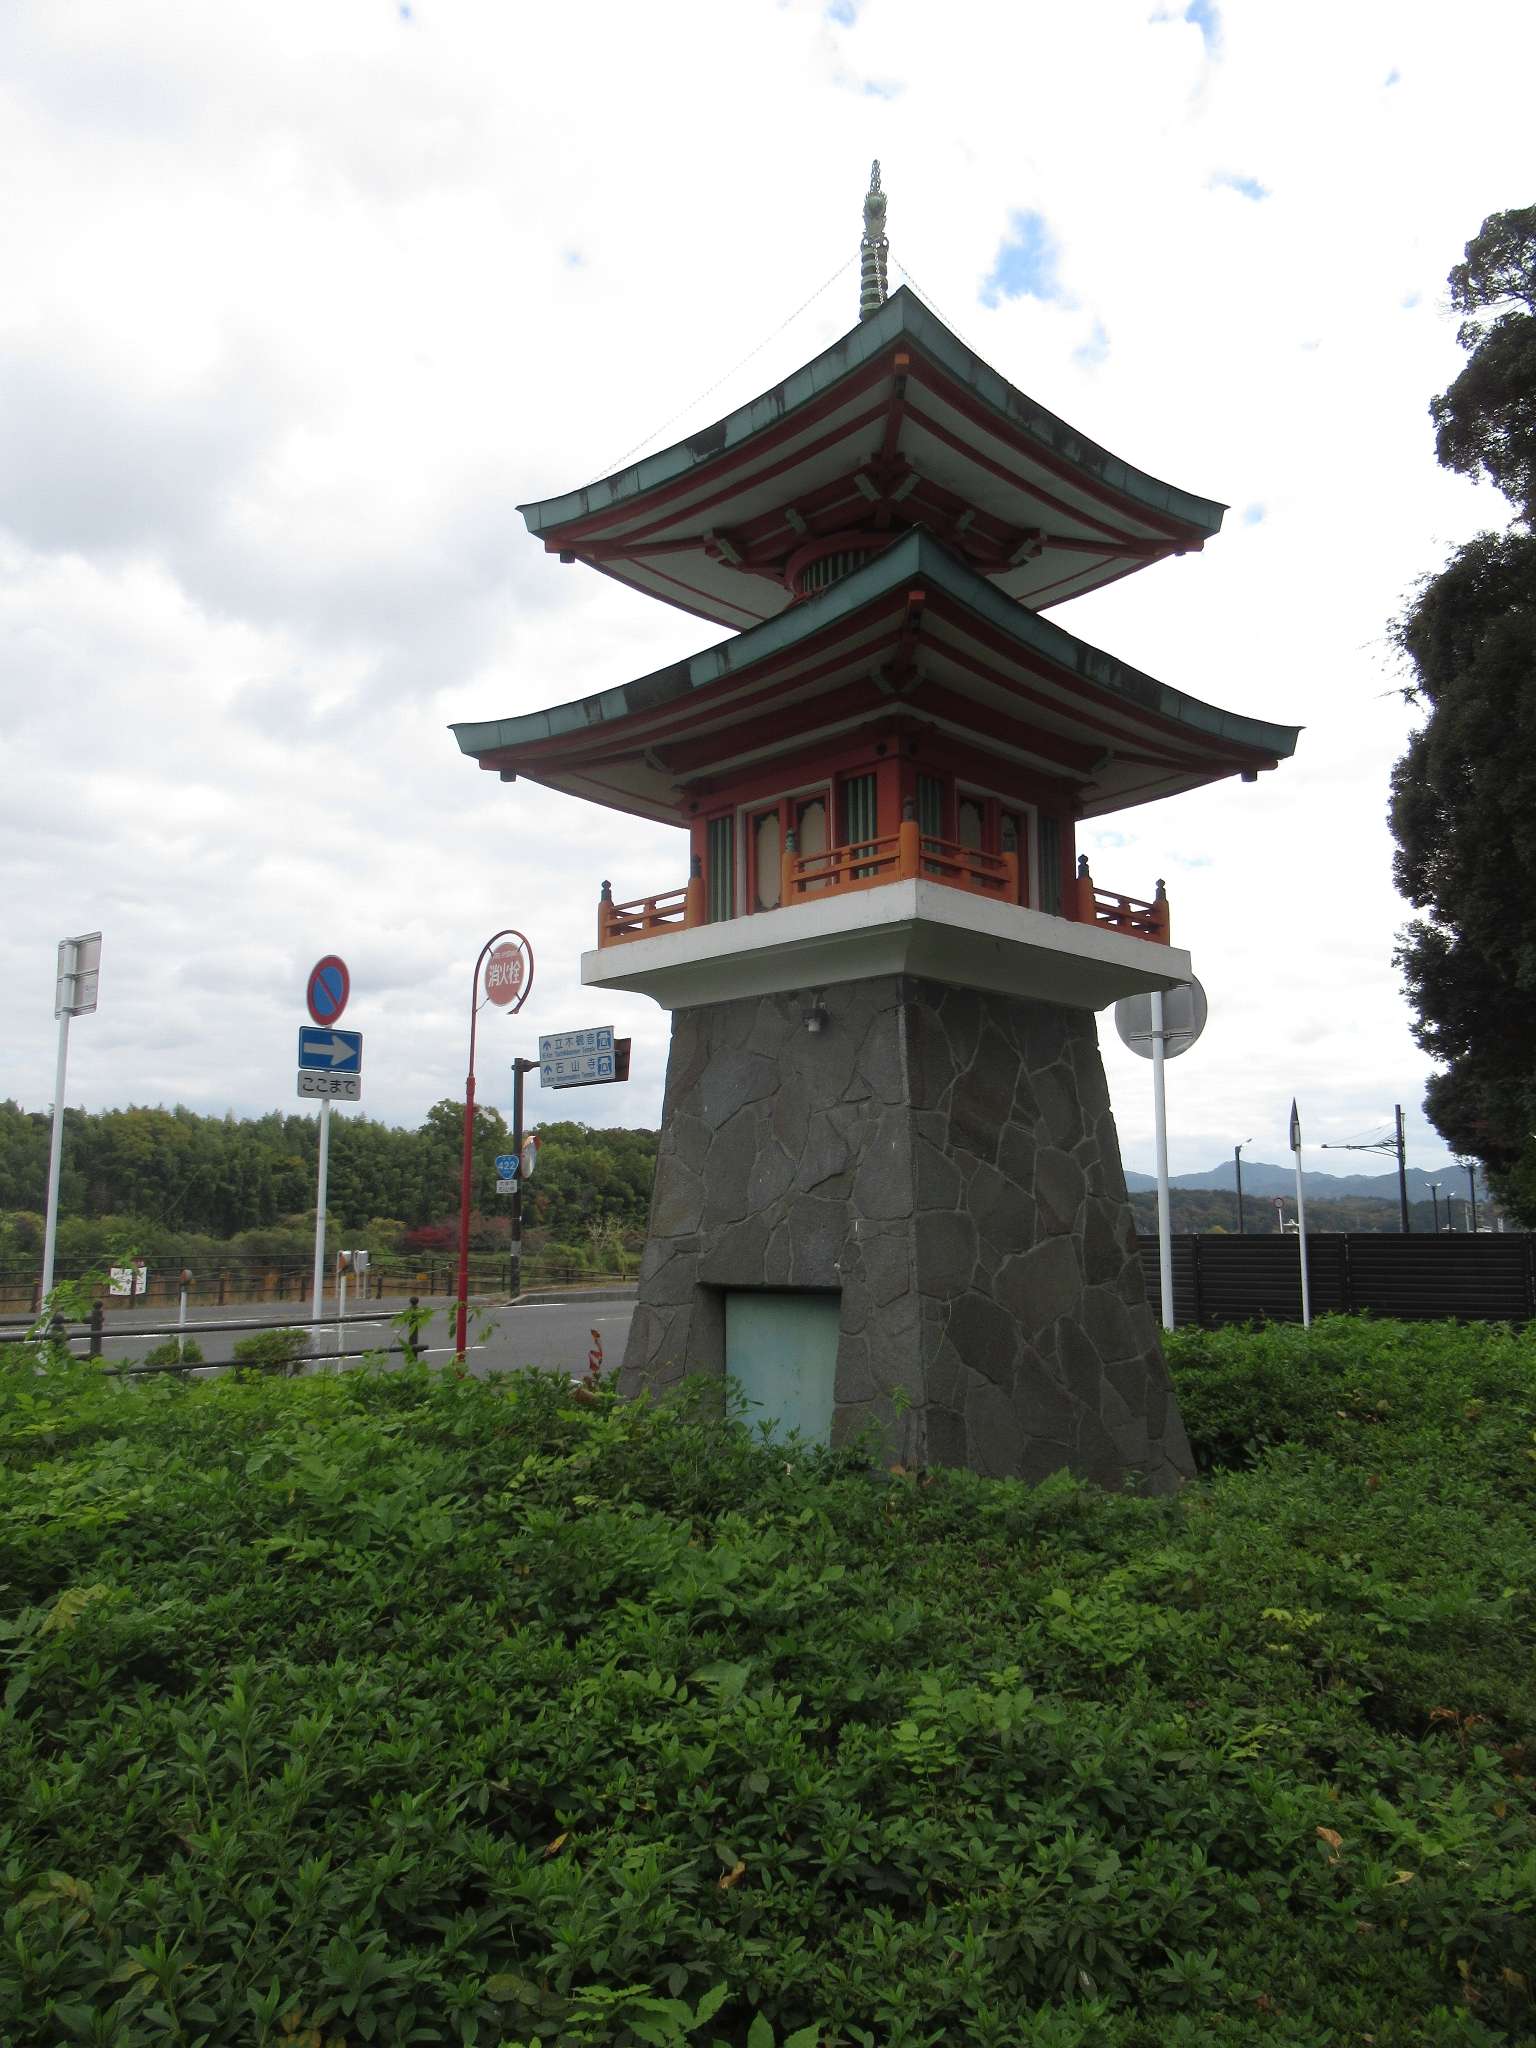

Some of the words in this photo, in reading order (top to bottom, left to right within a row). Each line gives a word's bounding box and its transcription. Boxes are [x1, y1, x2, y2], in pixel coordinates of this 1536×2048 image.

[488, 961, 521, 987] 消火栓
[554, 1033, 595, 1050] 立木観音
[556, 1058, 595, 1073] 石山寺
[303, 1077, 356, 1094] ここまで
[498, 1160, 516, 1169] 422
